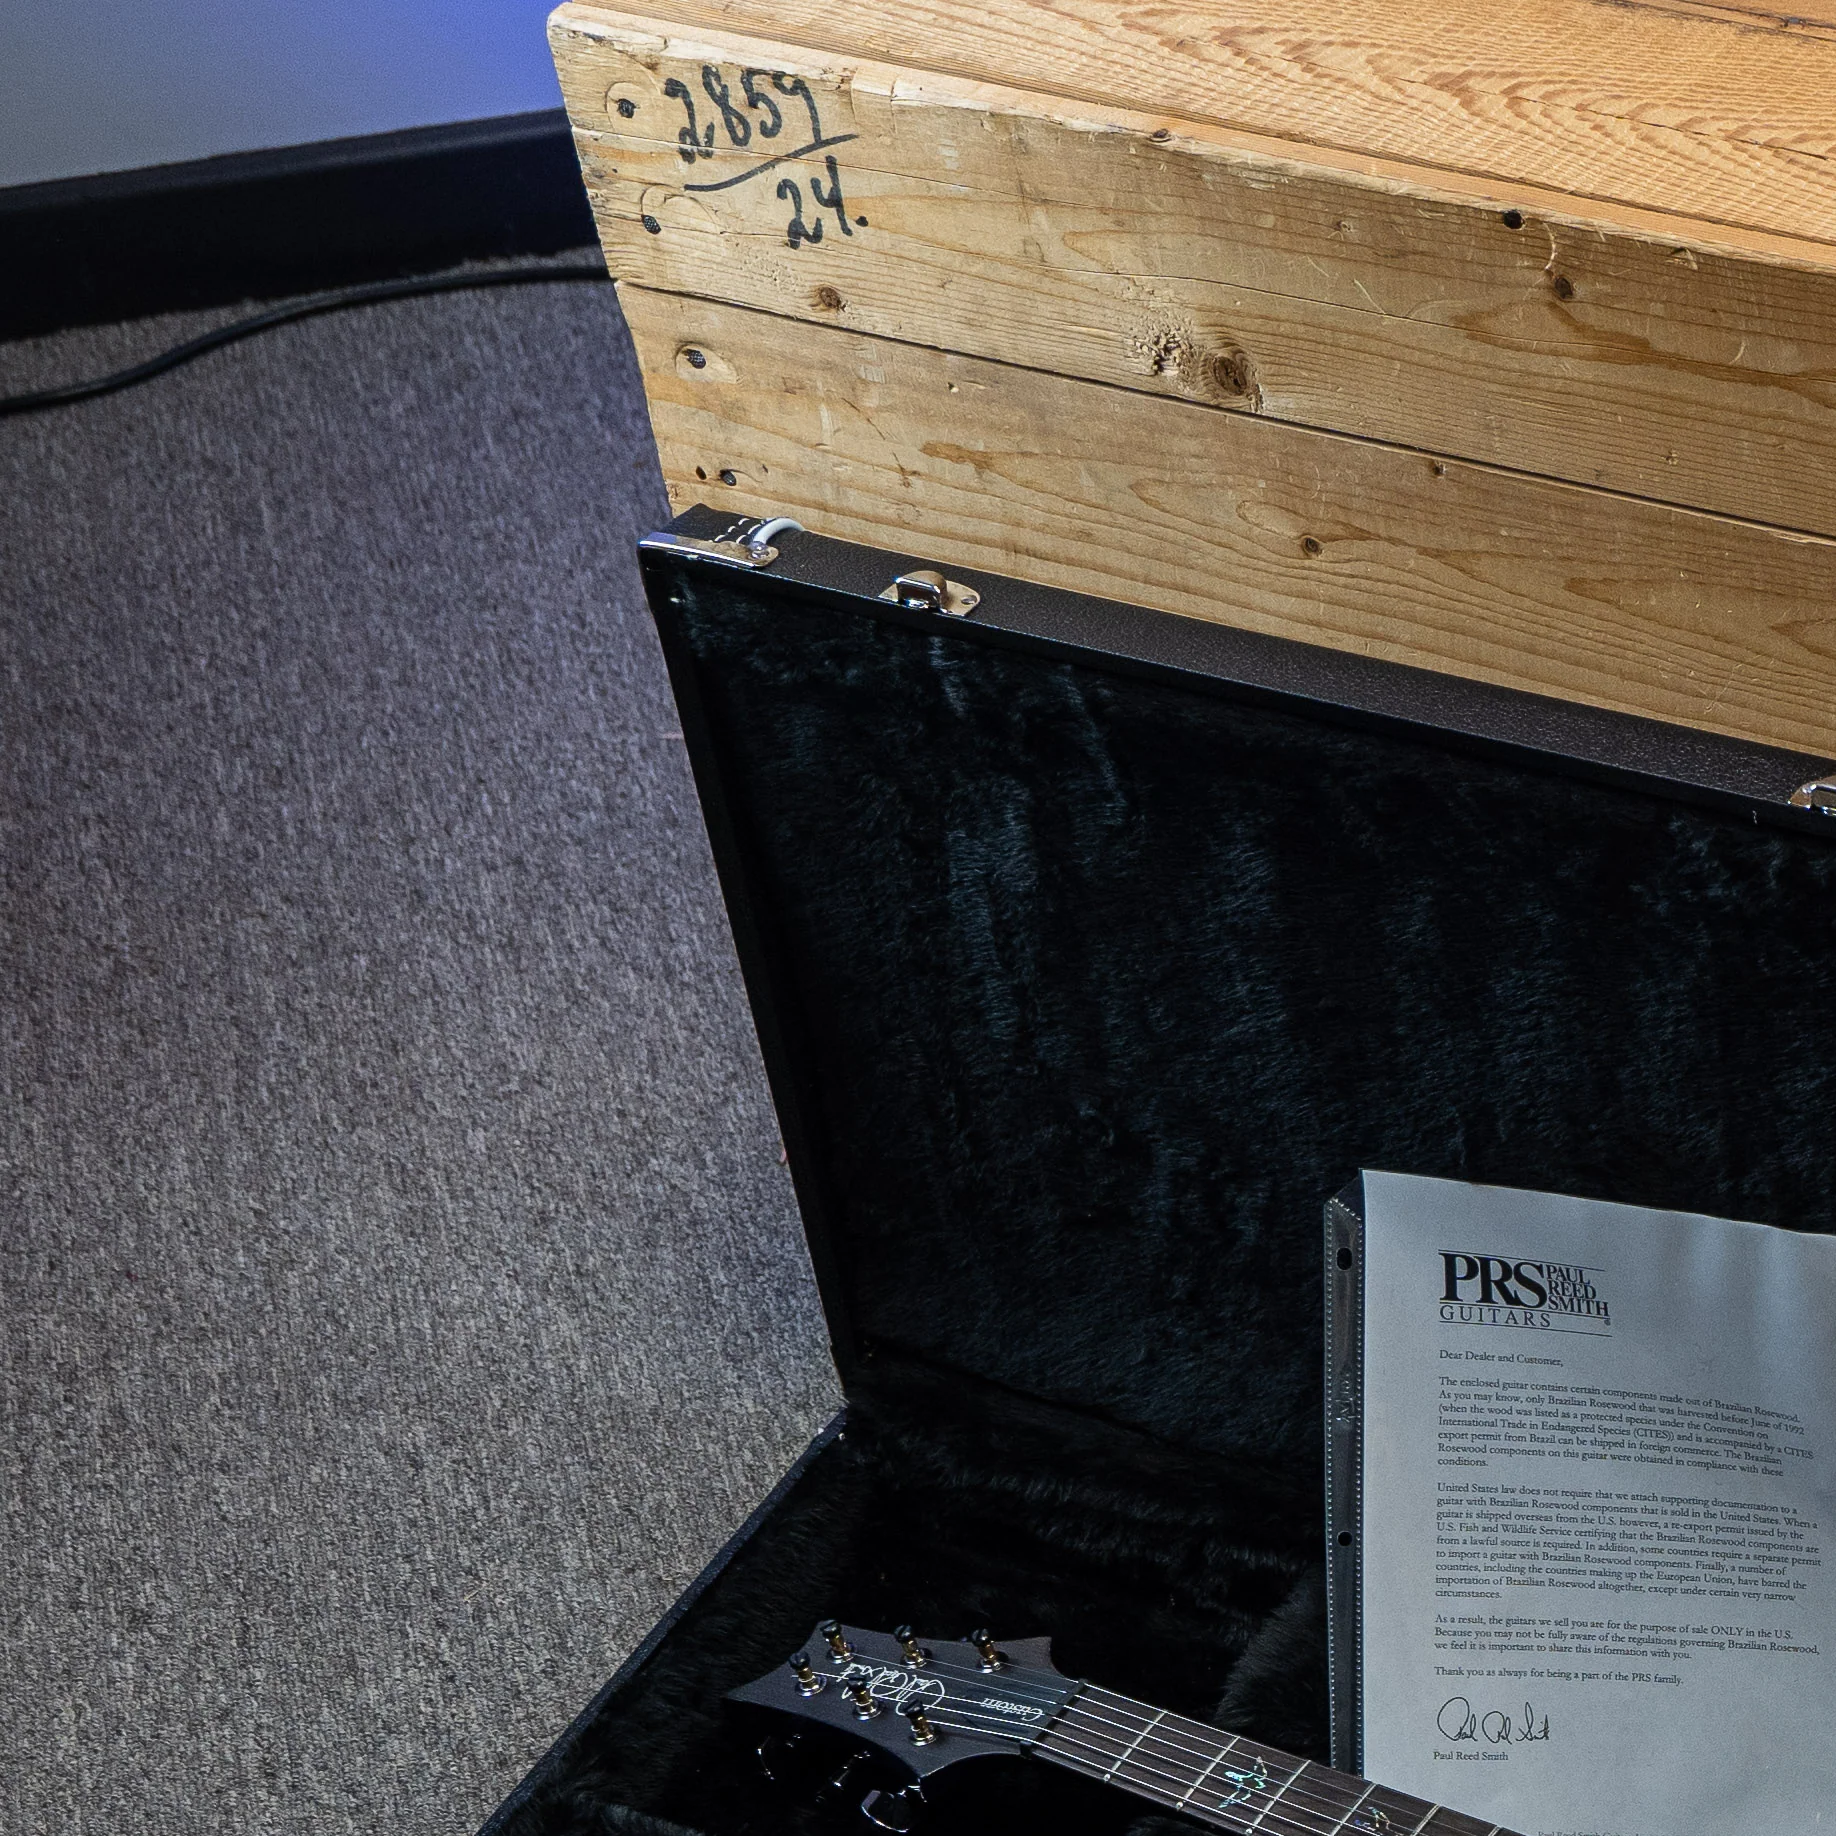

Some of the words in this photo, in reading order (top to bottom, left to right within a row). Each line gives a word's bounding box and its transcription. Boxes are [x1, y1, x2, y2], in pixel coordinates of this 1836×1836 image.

[1438, 1252, 1548, 1308] PRS
[1545, 1264, 1590, 1284] PAUL
[1548, 1279, 1597, 1300] REED
[1440, 1304, 1550, 1327] GUITARS
[1548, 1295, 1609, 1316] SMITH
[1439, 1349, 1463, 1360] Dear
[1464, 1350, 1495, 1361] Dealer
[1497, 1352, 1514, 1362] and
[1439, 1375, 1457, 1386] The
[1459, 1376, 1500, 1388] enclosed
[1501, 1379, 1528, 1391] guitar
[1659, 1392, 1683, 1403] made
[1685, 1396, 1700, 1405] out
[1701, 1396, 1712, 1407] of
[1714, 1397, 1752, 1413] Brazilian
[1438, 1388, 1451, 1399] As
[1453, 1392, 1471, 1402] you
[1473, 1393, 1493, 1404] may
[1525, 1394, 1545, 1407] only
[1547, 1394, 1587, 1407] Brazilian
[1589, 1397, 1636, 1411] Rosewood
[1638, 1401, 1656, 1413] that
[1720, 1410, 1749, 1424] before
[1750, 1415, 1771, 1428] June
[1772, 1420, 1782, 1430] of
[1782, 1421, 1804, 1435] 1992
[1437, 1441, 1487, 1454] Rosewood
[1562, 1447, 1579, 1458] this
[1581, 1449, 1608, 1462] guitar
[1609, 1453, 1631, 1462] were
[1633, 1452, 1673, 1465] obtained
[1675, 1455, 1684, 1466] in
[1686, 1458, 1737, 1471] compliance
[1738, 1462, 1758, 1473] with
[1761, 1464, 1783, 1476] these
[1483, 1561, 1526, 1576] including
[1528, 1563, 1543, 1574] the
[1545, 1565, 1587, 1576] countries
[1589, 1566, 1622, 1580] making
[1624, 1570, 1637, 1581] up
[1639, 1569, 1654, 1579] the
[1656, 1569, 1701, 1584] European
[1737, 1574, 1759, 1586] have
[1761, 1576, 1790, 1588] barred
[1792, 1578, 1807, 1589] the
[1434, 1613, 1447, 1623] As
[1488, 1614, 1503, 1624] the
[1505, 1615, 1536, 1627] guitars
[1537, 1618, 1552, 1626] we
[1553, 1616, 1569, 1627] sell
[1571, 1620, 1588, 1630] you
[1589, 1620, 1604, 1628] are
[1606, 1618, 1621, 1629] for
[1623, 1619, 1637, 1630] the
[1639, 1623, 1676, 1634] purpose
[1678, 1622, 1688, 1633] of
[1691, 1623, 1708, 1634] sale
[1710, 1624, 1743, 1636] ONLY
[1745, 1626, 1754, 1637] in
[1757, 1627, 1772, 1638] the
[1434, 1626, 1472, 1637] Because
[1474, 1630, 1492, 1640] you
[1493, 1630, 1513, 1640] may
[1515, 1629, 1531, 1638] not
[1533, 1628, 1545, 1639] be
[1547, 1629, 1568, 1642] fully
[1569, 1632, 1596, 1641] aware
[1597, 1631, 1608, 1642] of
[1610, 1631, 1625, 1642] the
[1627, 1633, 1677, 1646] regulations
[1679, 1637, 1725, 1651] governing
[1727, 1638, 1767, 1650] Brazilian
[1450, 1639, 1467, 1650] feel
[1469, 1640, 1476, 1650] it
[1478, 1640, 1486, 1650] is
[1488, 1640, 1534, 1653] important
[1536, 1642, 1547, 1652] to
[1548, 1641, 1573, 1653] share
[1575, 1642, 1591, 1653] this
[1593, 1643, 1647, 1656] information
[1649, 1647, 1670, 1658] with
[1434, 1665, 1464, 1676] Thank
[1466, 1668, 1484, 1678] you
[1497, 1666, 1527, 1679] always
[1530, 1667, 1544, 1678] for
[1546, 1667, 1572, 1681] being
[1581, 1671, 1600, 1682] part
[1601, 1670, 1612, 1680] of
[1614, 1670, 1629, 1681] the
[1631, 1671, 1651, 1682] PRS
[980, 1698, 1045, 1721] Custom
[1433, 1752, 1453, 1760] Paul
[1456, 1752, 1479, 1760] Reed
[1482, 1752, 1509, 1761] Smith
